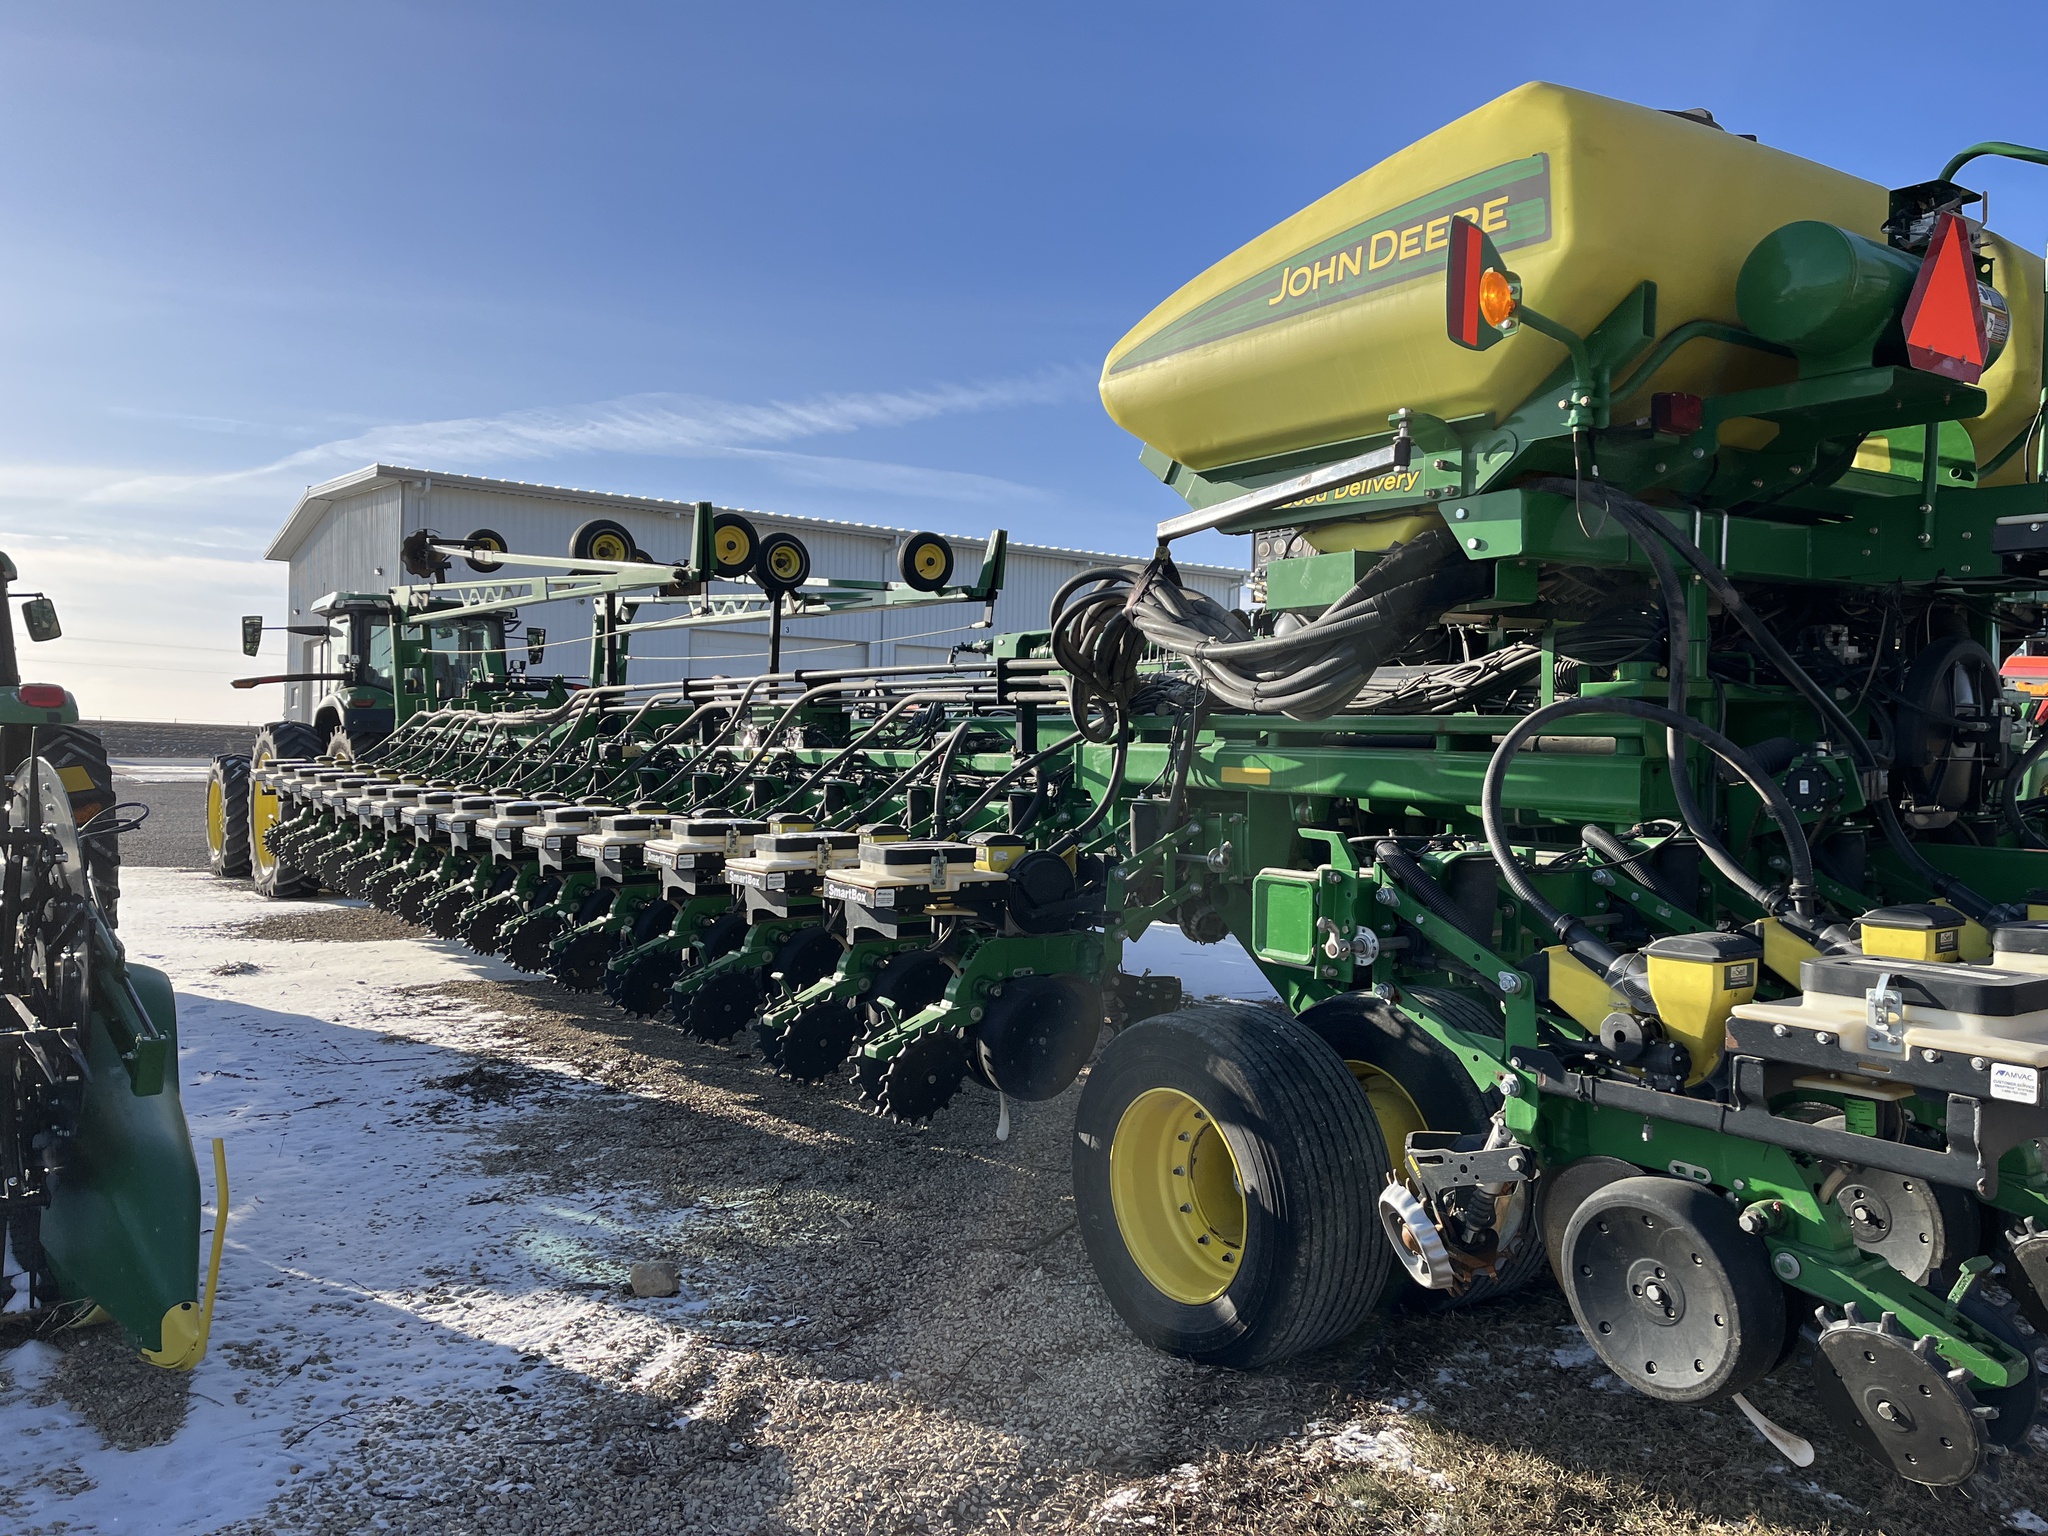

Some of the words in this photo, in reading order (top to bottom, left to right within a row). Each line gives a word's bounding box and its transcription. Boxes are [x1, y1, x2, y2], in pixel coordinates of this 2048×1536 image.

[1269, 246, 1362, 306] JOHN
[1334, 470, 1420, 499] Delivery
[785, 626, 790, 634] 3
[729, 870, 760, 887] SmartBox
[828, 884, 867, 903] SmartBox
[2005, 1071, 2034, 1081] AMVAC
